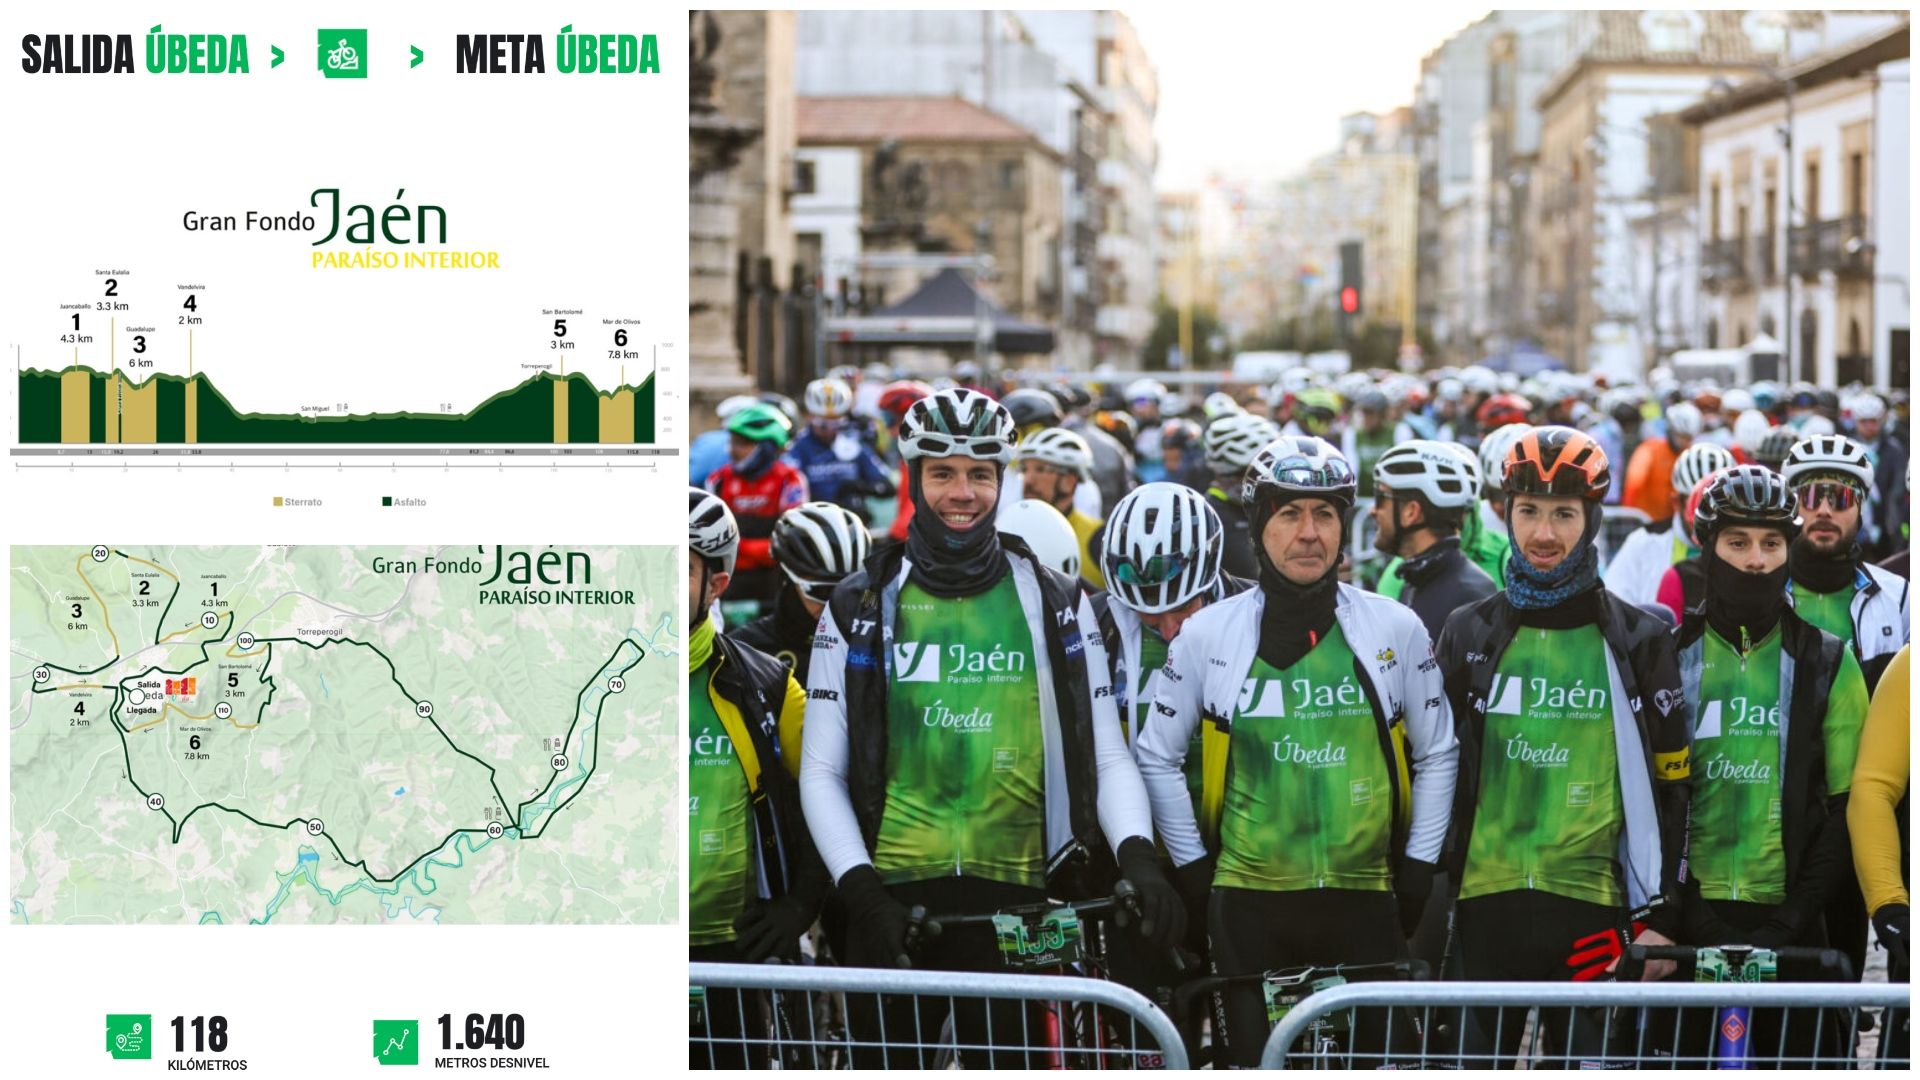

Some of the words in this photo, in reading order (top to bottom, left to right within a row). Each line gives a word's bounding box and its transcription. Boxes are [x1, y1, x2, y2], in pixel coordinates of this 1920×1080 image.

[949, 643, 1025, 674] Jaén
[987, 674, 1022, 683] interior
[1530, 677, 1606, 709] Jaén
[922, 699, 992, 728] Úbeda
[1338, 707, 1372, 716] interio
[1730, 696, 1780, 726] Jaé
[689, 727, 732, 755] én
[1272, 734, 1347, 764] Úbeda
[1506, 732, 1570, 763] Úbeda
[1706, 752, 1771, 780] Úbeda
